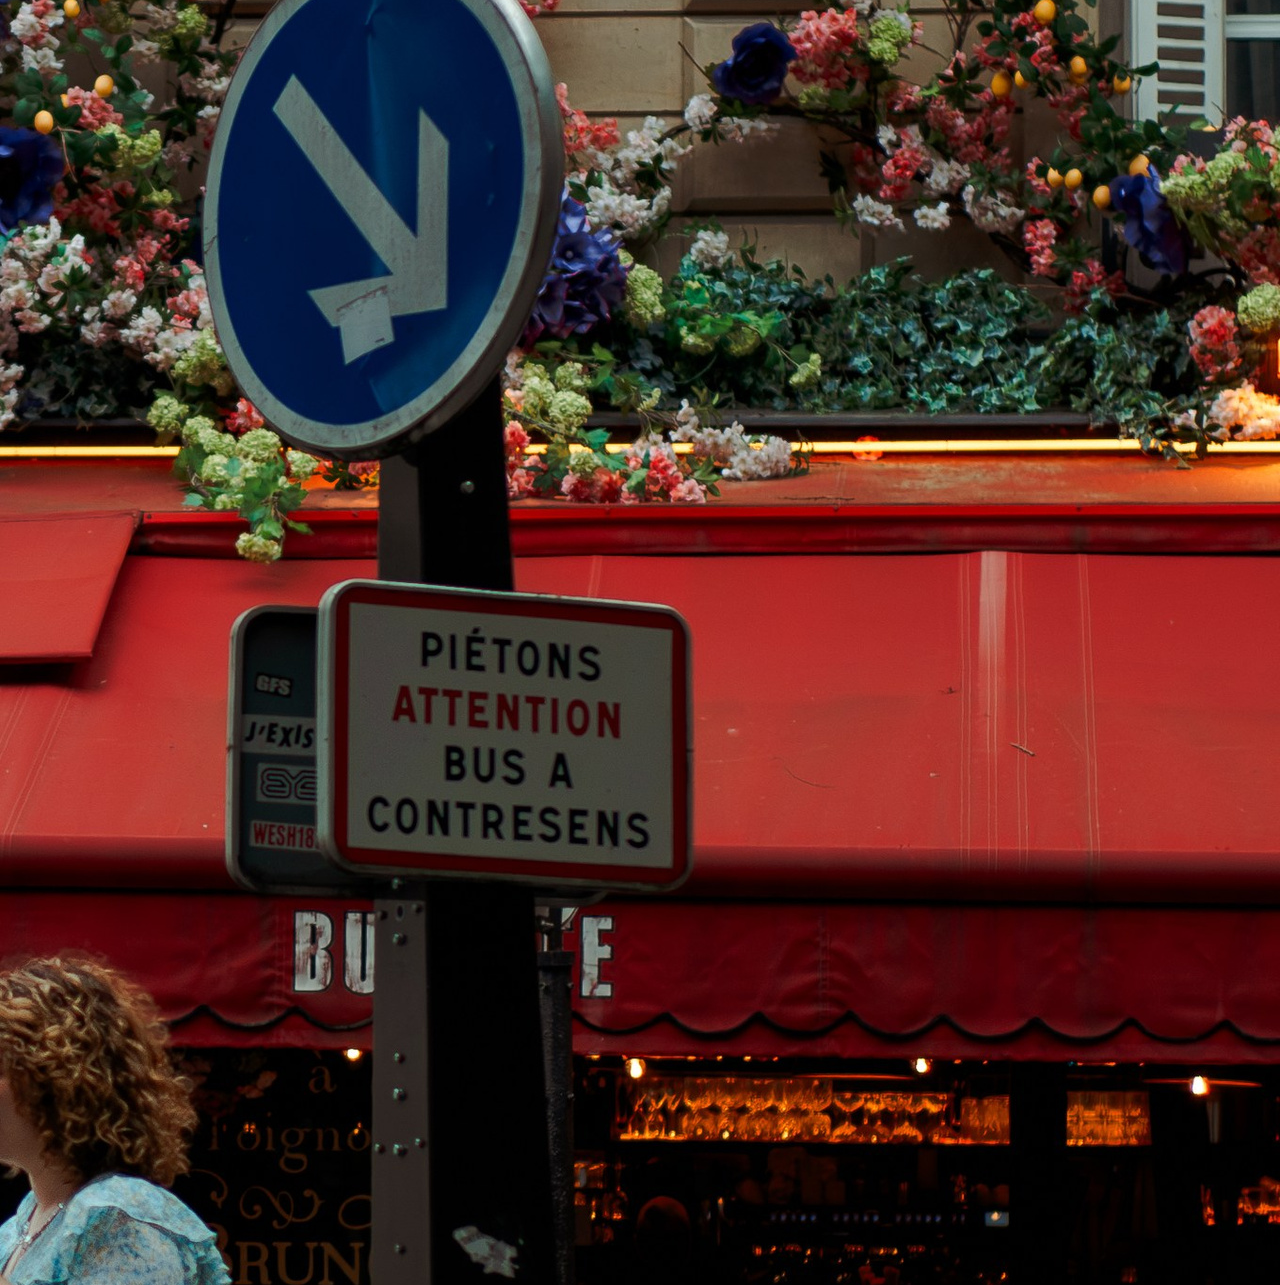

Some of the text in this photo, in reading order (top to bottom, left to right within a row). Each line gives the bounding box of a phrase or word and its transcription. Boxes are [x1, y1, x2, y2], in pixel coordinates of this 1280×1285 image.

[422, 627, 600, 681] PIÉTONS
[256, 675, 291, 696] GFS
[392, 686, 621, 739] ATTENTION
[245, 721, 315, 749] J'EXIS
[446, 746, 573, 789] BUS A
[253, 822, 318, 850] WESH18
[369, 797, 650, 849] CONTRESENS
